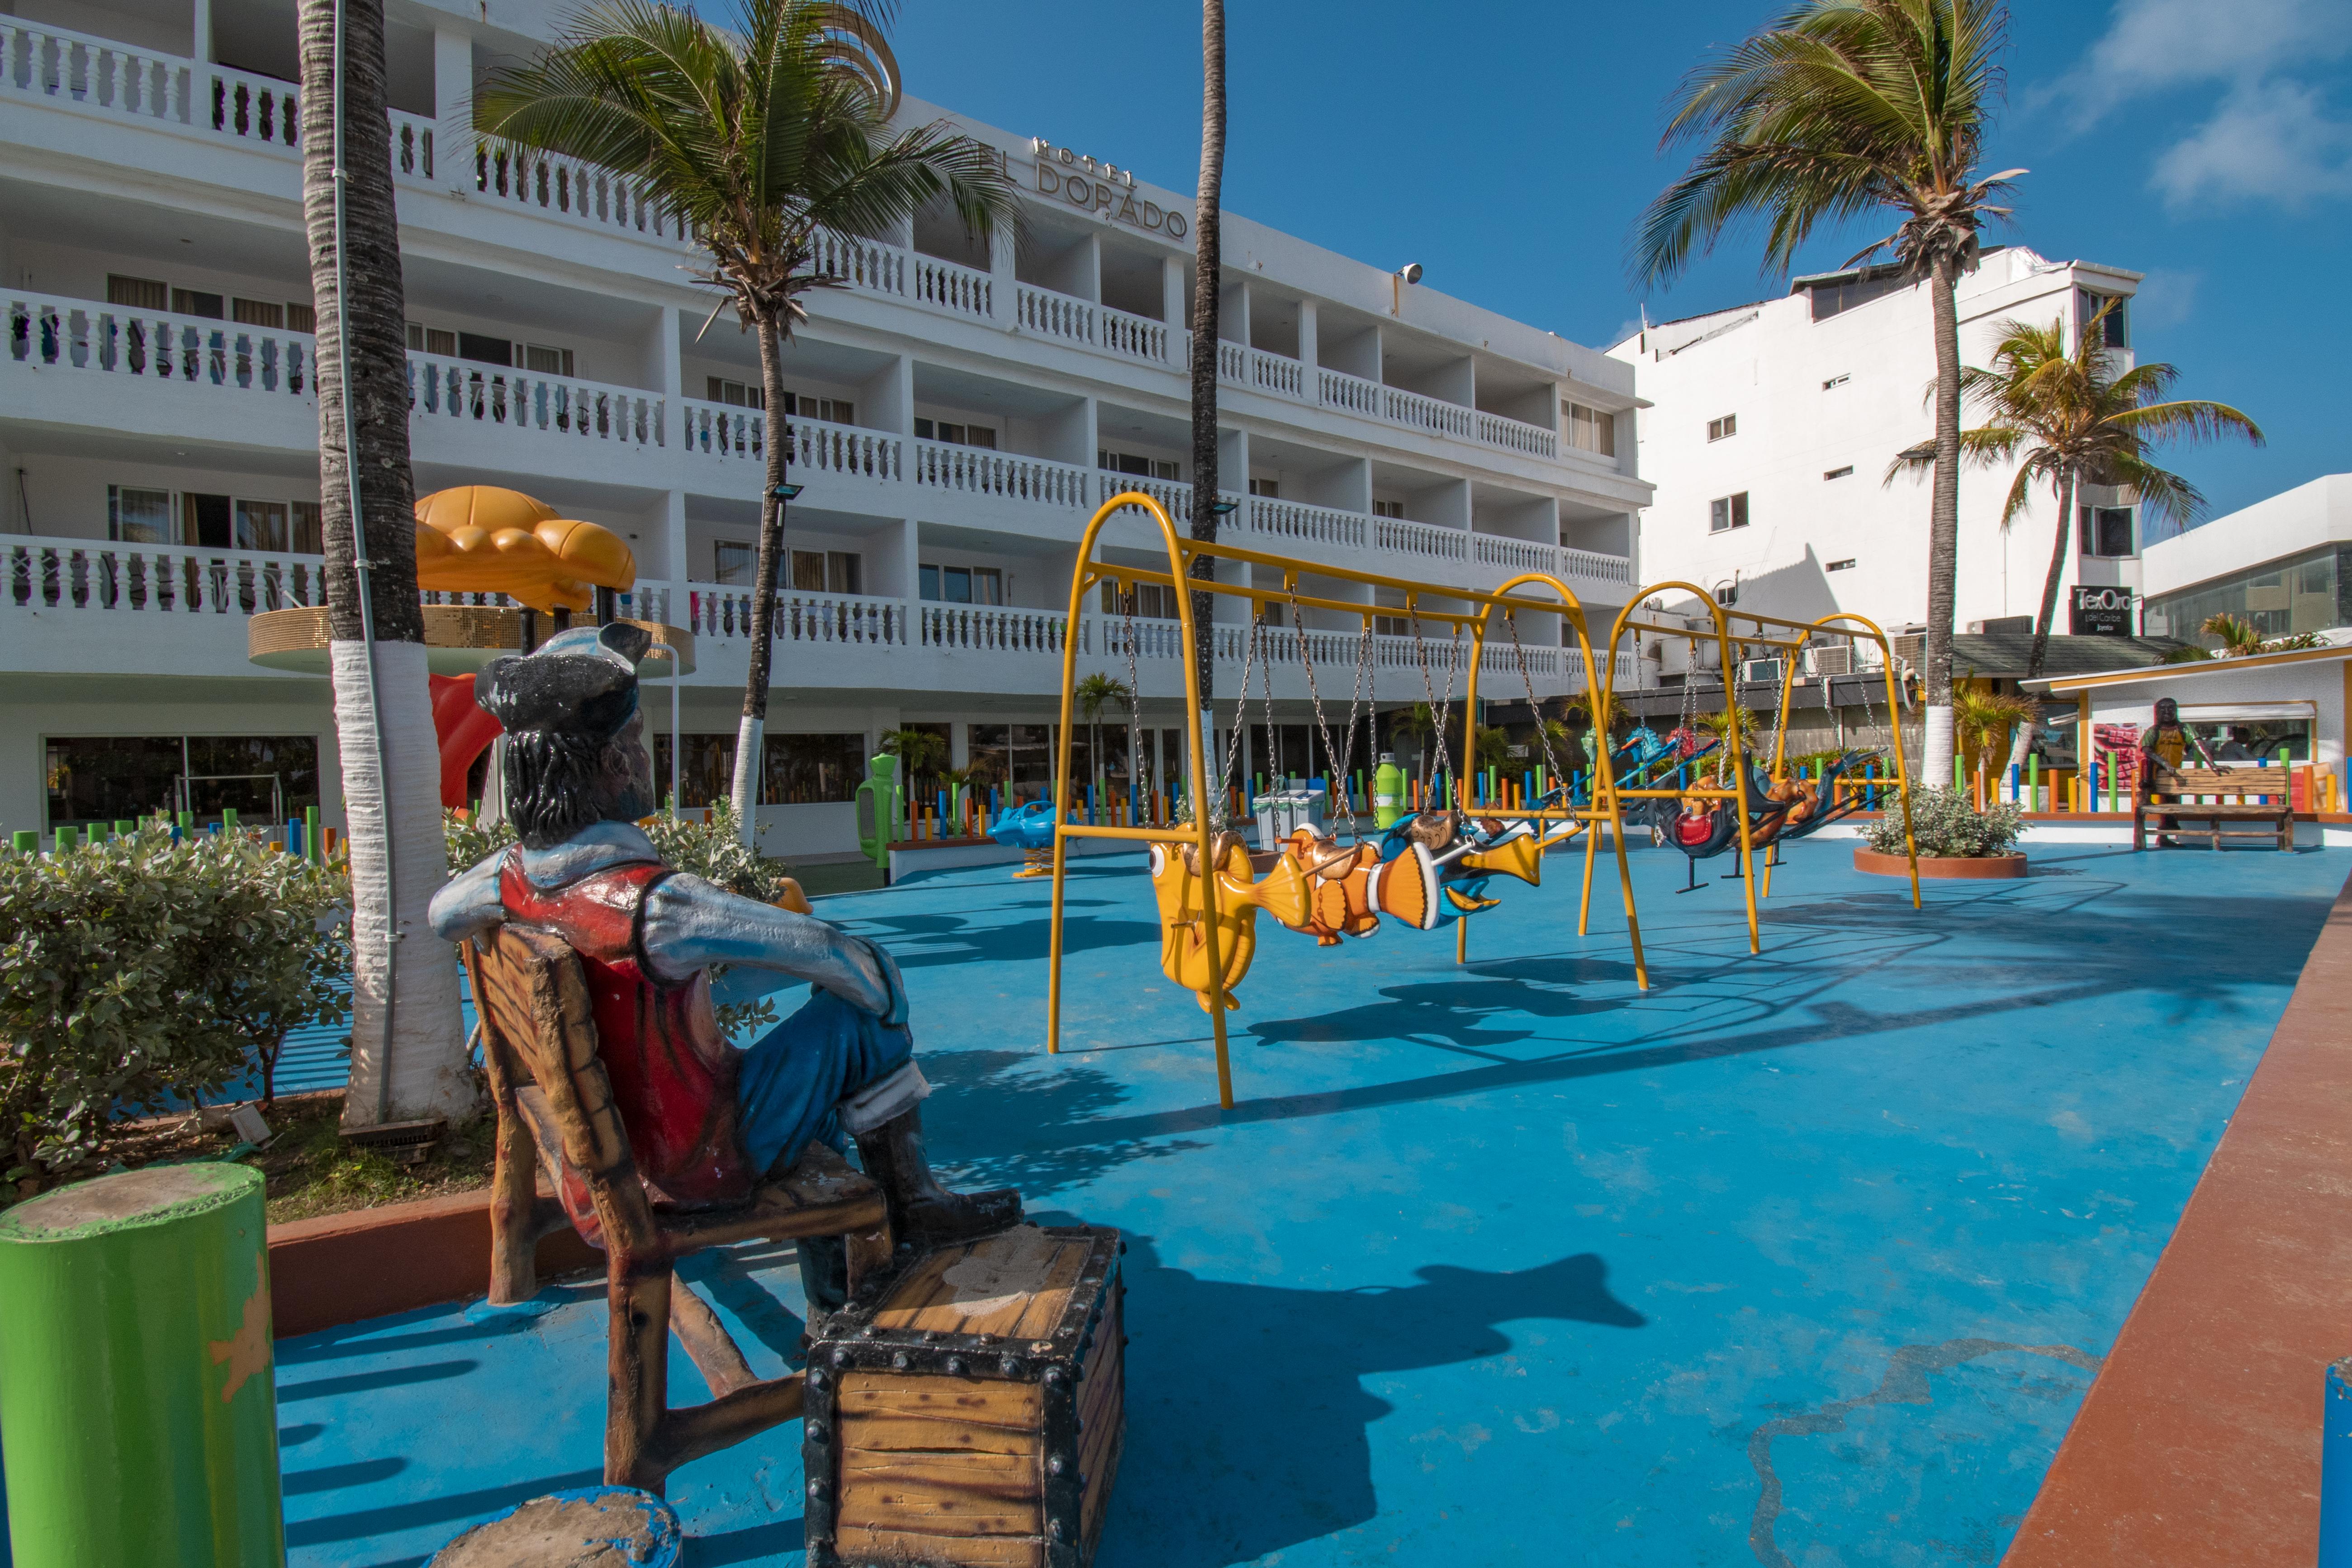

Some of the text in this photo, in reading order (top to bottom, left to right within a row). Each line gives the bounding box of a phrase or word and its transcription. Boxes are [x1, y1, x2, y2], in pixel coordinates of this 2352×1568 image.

[1033, 137, 1137, 189] HOTEL
[1037, 162, 1187, 238] DORADO
[2099, 613, 2120, 622] Caribe
